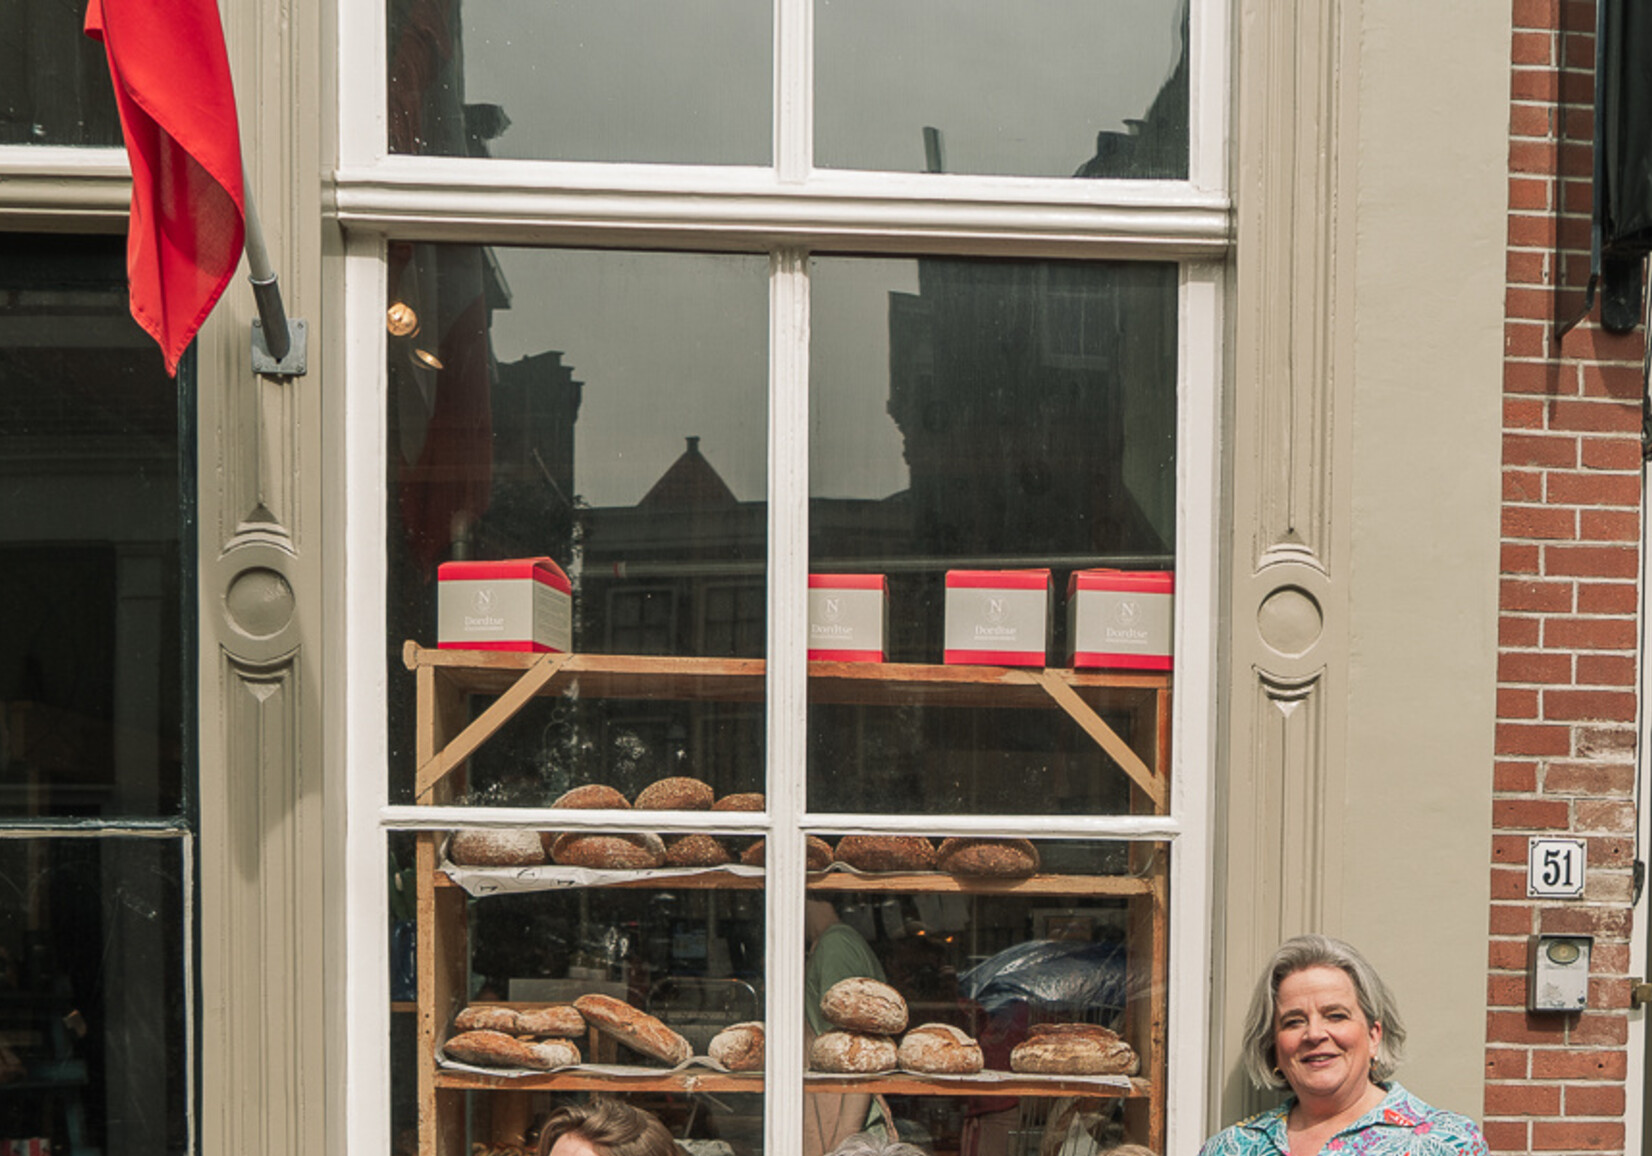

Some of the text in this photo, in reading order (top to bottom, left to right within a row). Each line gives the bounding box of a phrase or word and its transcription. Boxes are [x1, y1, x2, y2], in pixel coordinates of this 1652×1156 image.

[478, 590, 491, 604] N
[826, 599, 839, 613] N
[990, 599, 1003, 613] N
[1121, 602, 1135, 617] N
[464, 616, 504, 625] Dordtse
[1543, 849, 1573, 886] 51
